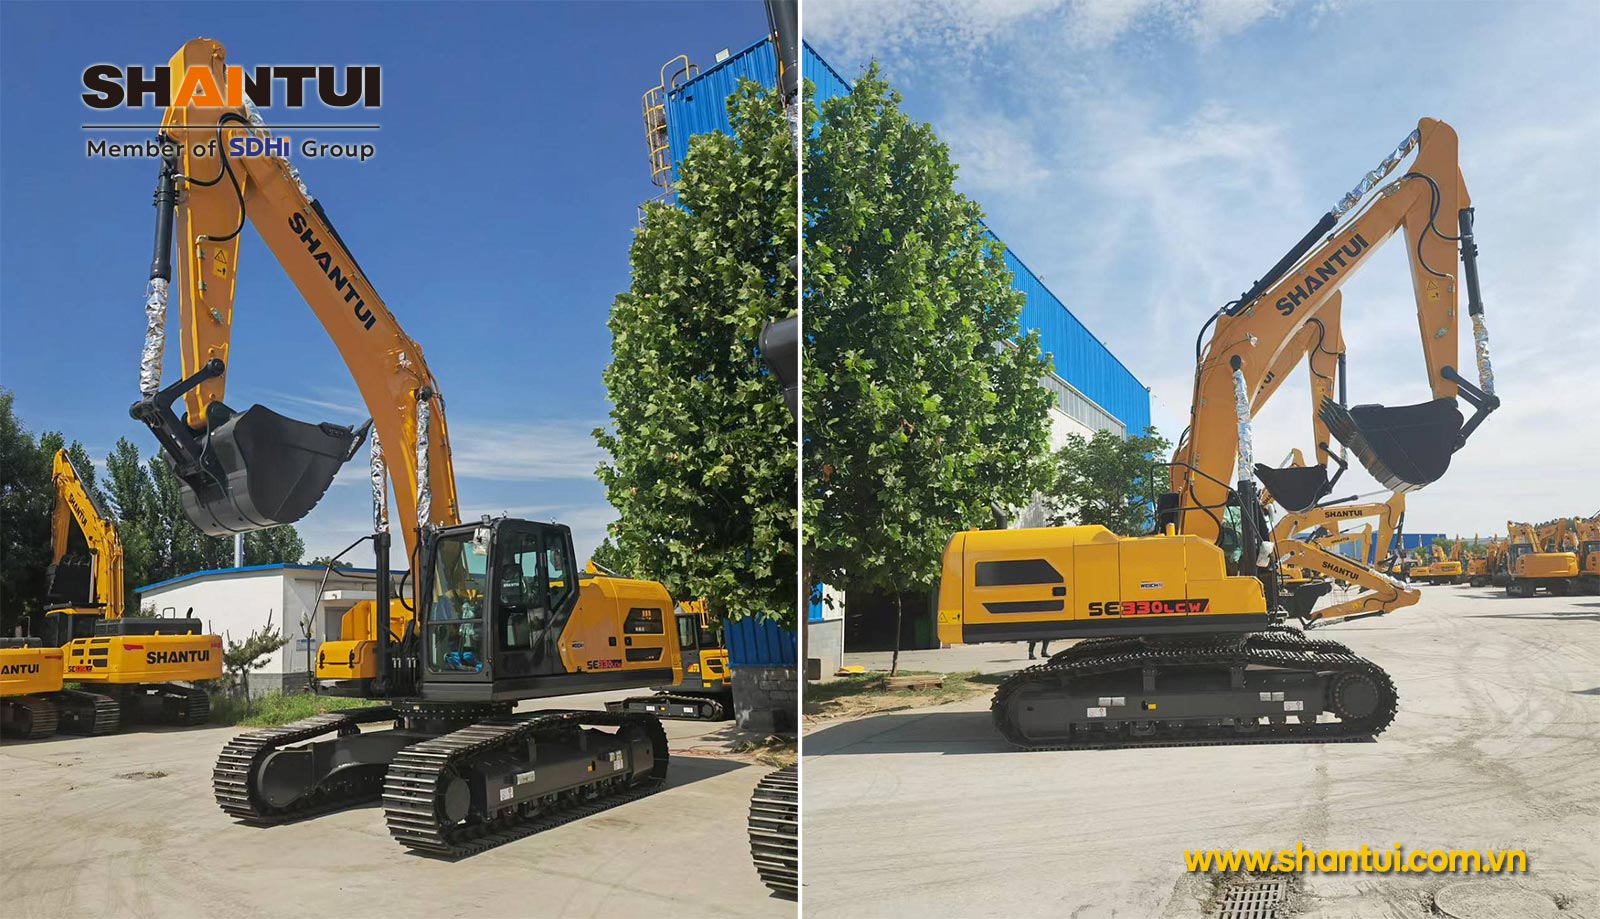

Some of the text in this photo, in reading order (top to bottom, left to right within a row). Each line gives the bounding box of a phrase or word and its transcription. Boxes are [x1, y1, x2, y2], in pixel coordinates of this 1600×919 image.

[288, 212, 377, 331] SHANTUI
[1276, 233, 1370, 317] SHANTUI
[69, 492, 88, 527] SHANTUI
[1324, 510, 1363, 518] SHANTUI
[1321, 560, 1360, 581] SHANTUI
[1088, 600, 1201, 616] SE330LCW
[146, 650, 210, 665] SHANTUI
[1, 664, 40, 675] ANTUI
